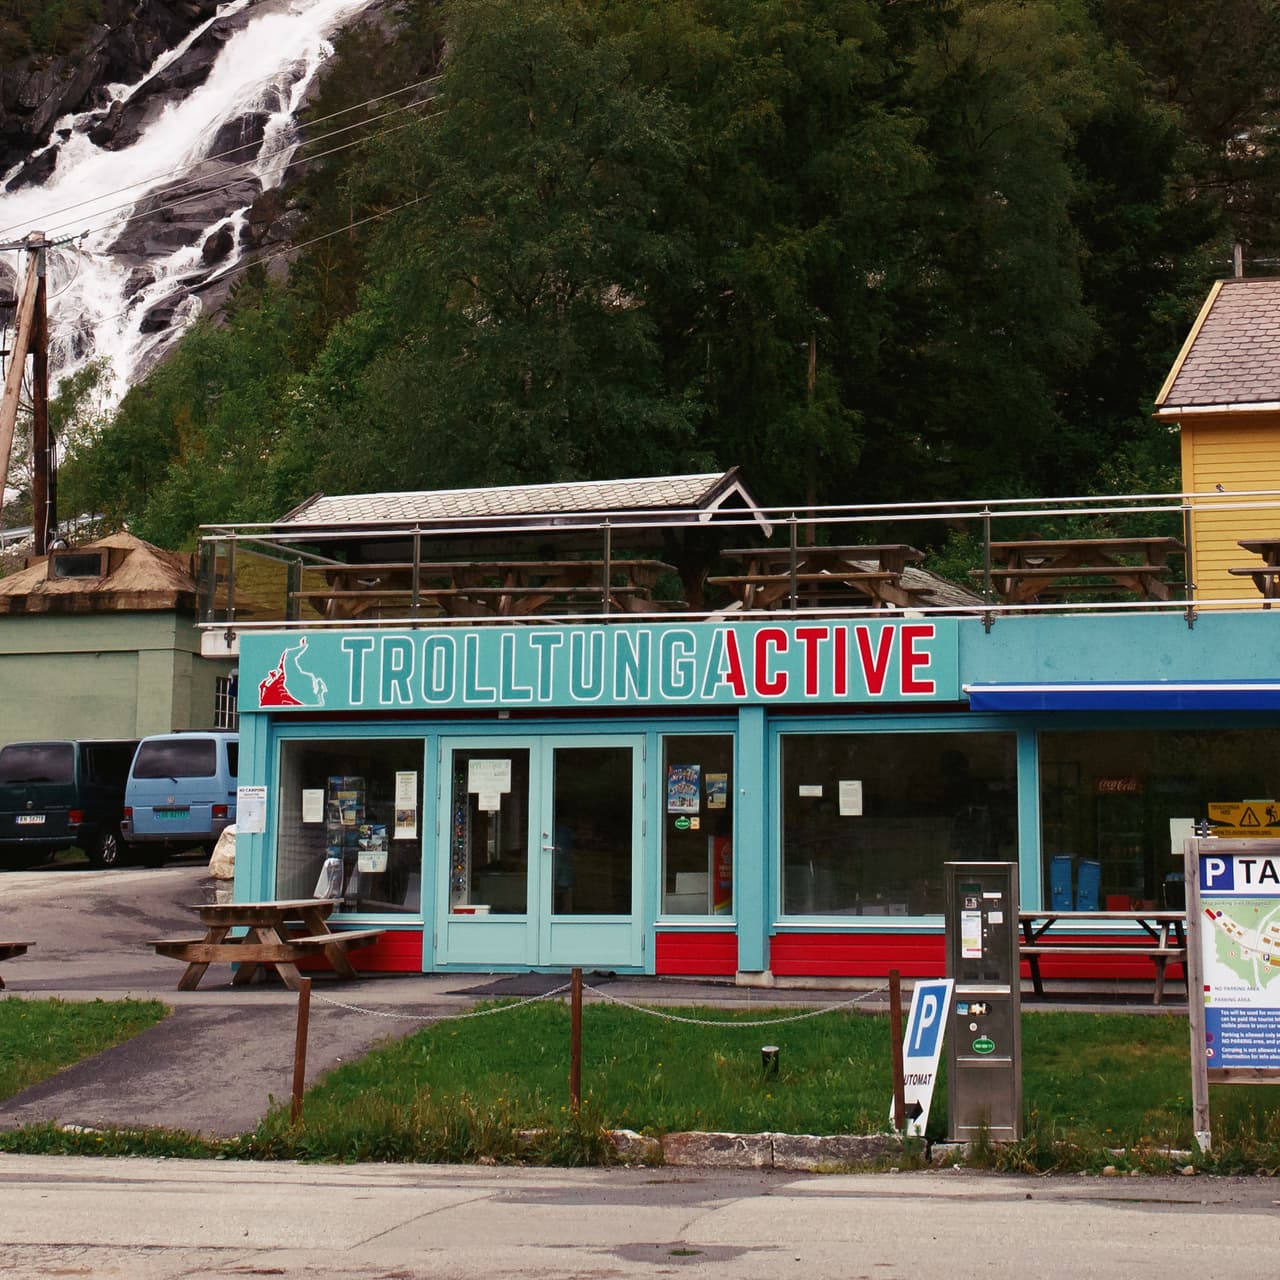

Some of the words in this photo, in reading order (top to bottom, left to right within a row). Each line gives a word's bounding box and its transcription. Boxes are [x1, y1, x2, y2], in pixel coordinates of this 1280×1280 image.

[341, 624, 937, 705] TROLLTUNGACTIVE
[1205, 857, 1226, 887] P
[904, 1073, 933, 1086] UTOMAT
